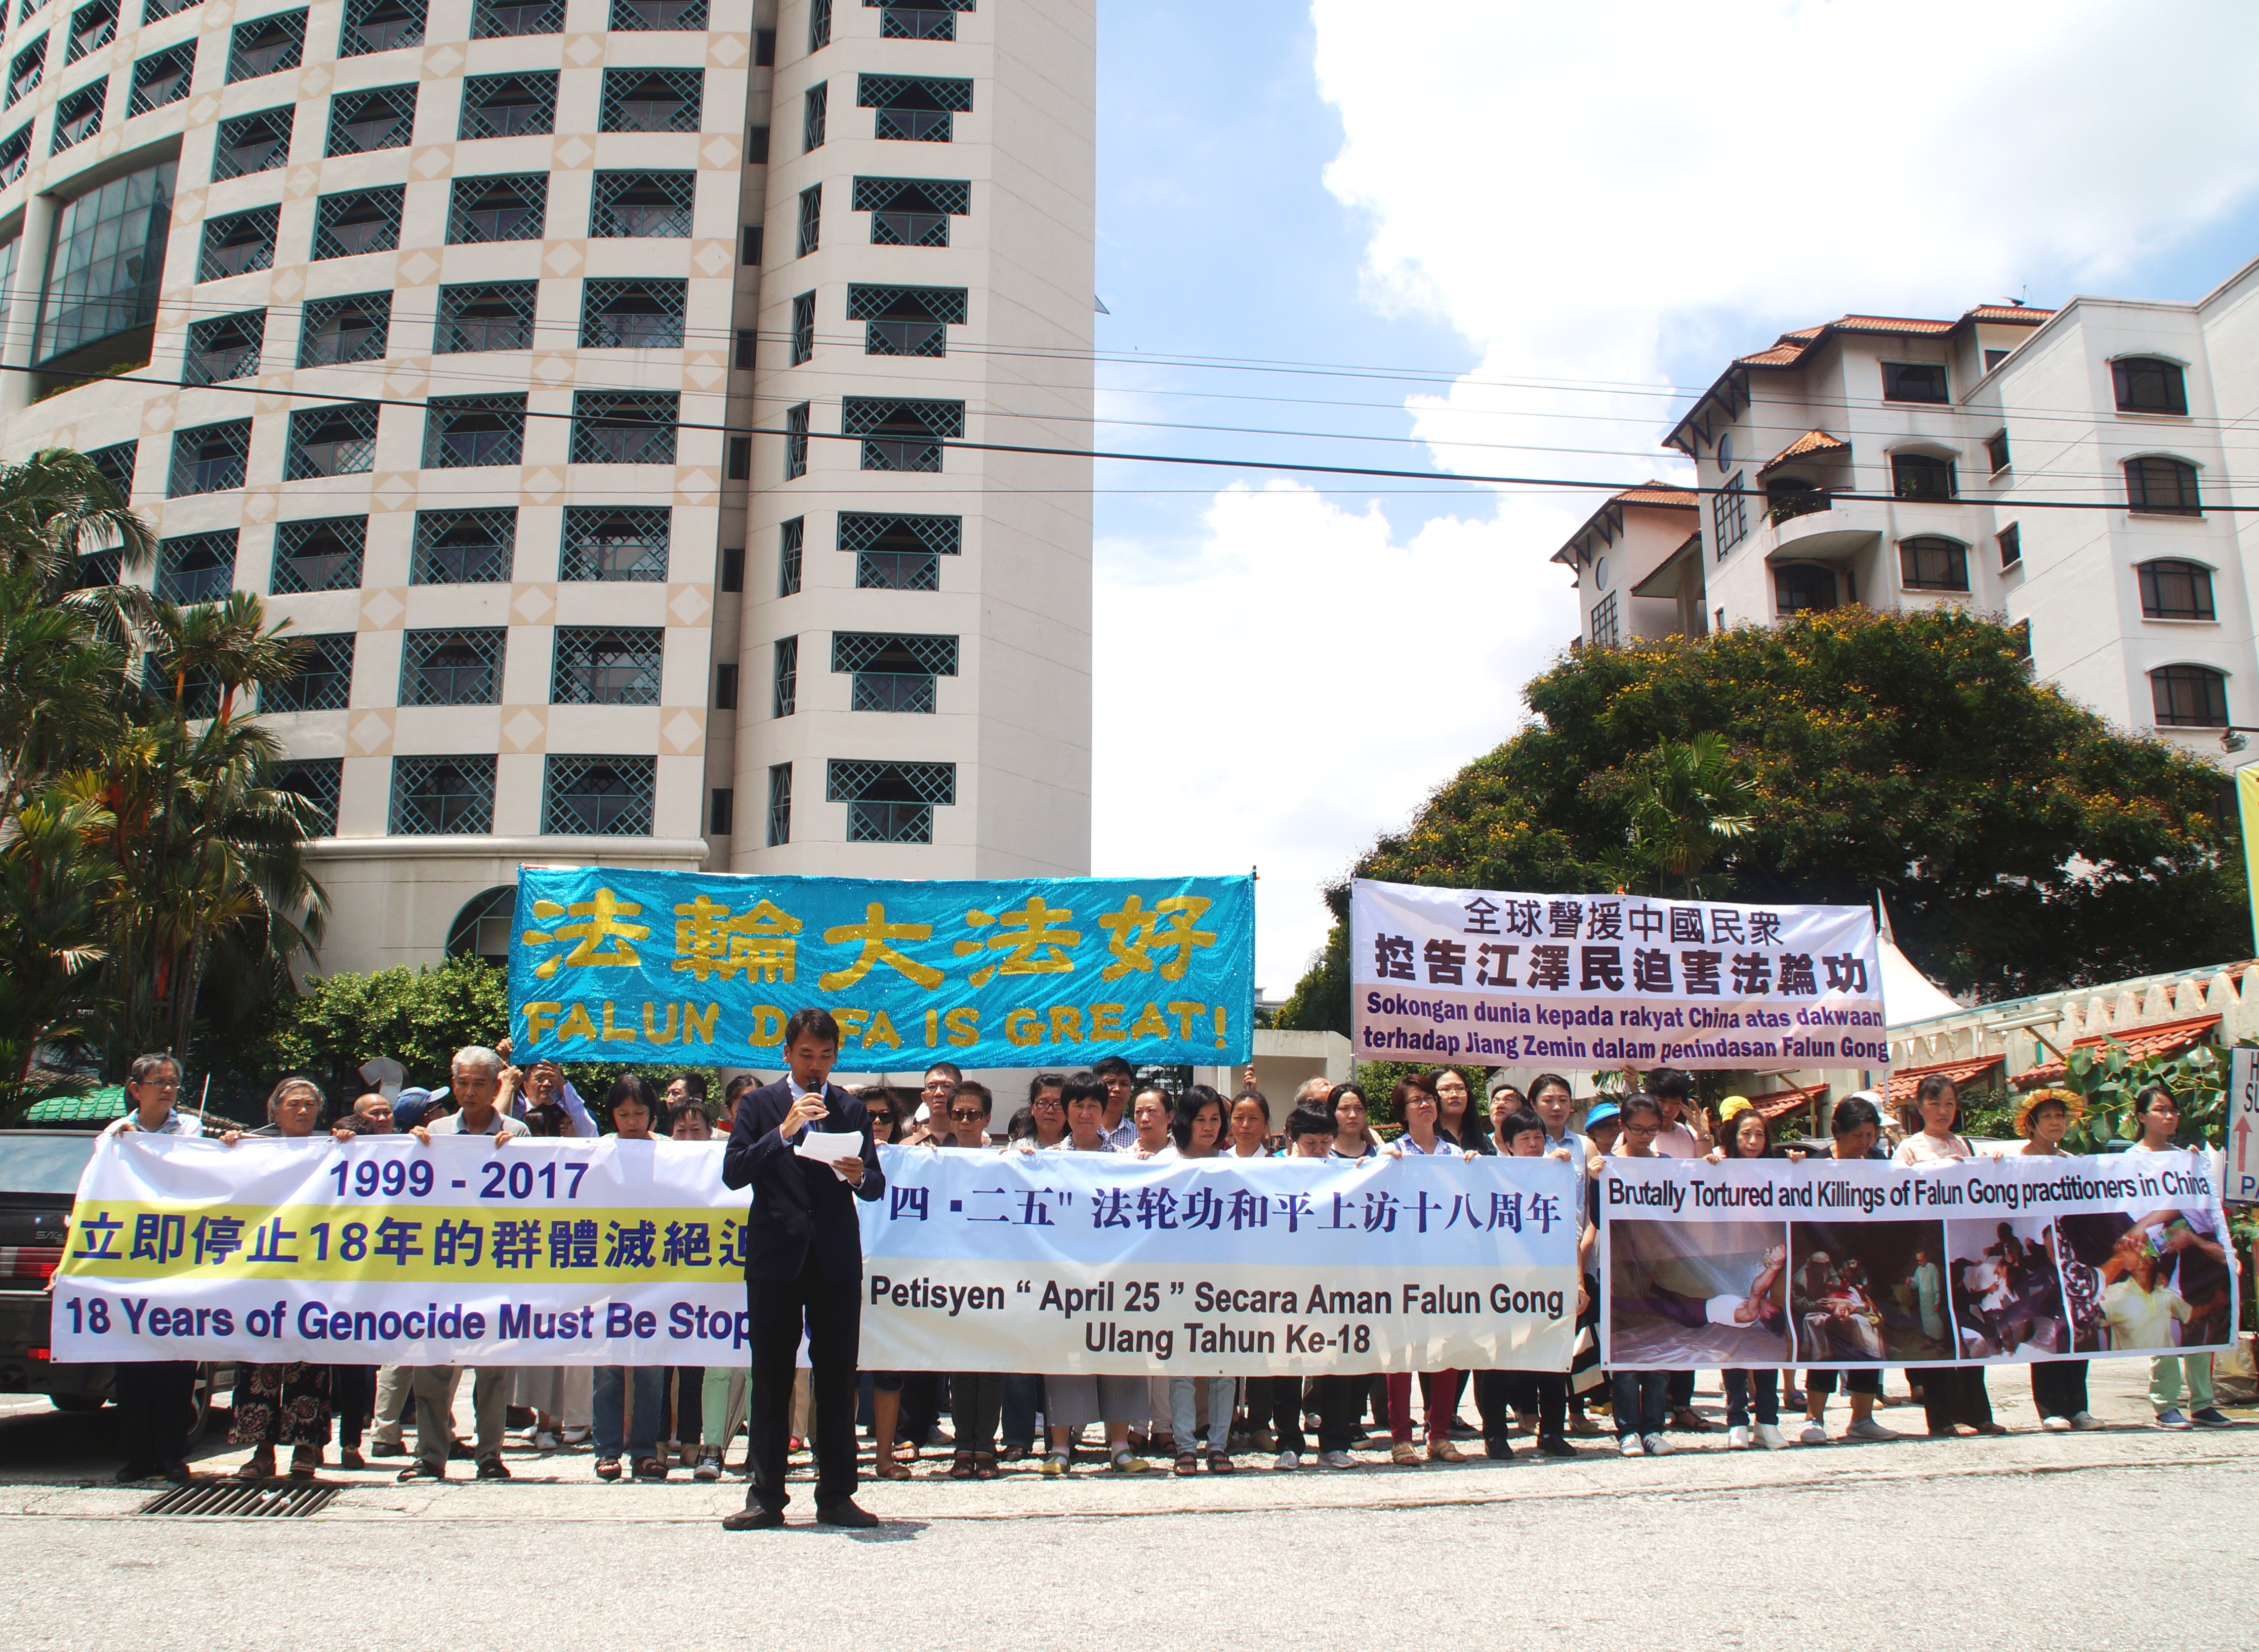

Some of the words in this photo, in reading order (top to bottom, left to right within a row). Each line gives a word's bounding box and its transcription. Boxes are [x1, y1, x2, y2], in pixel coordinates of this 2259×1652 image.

[523, 889, 1216, 990] 法輪大法好
[1375, 933, 1867, 996] 控告江澤民迫害法輪功
[523, 1002, 718, 1043] FALUN
[750, 1006, 900, 1049] DFA
[927, 1008, 978, 1047] IS
[1006, 1002, 1225, 1048] GREAT!
[1367, 992, 1467, 1022] Sokongan
[1474, 1001, 1531, 1023] dunia
[1537, 1004, 1613, 1029] kepada
[1620, 1007, 1683, 1031] rakyat
[1689, 1008, 1740, 1028] China
[1745, 1009, 1790, 1027] atas
[1796, 1007, 1883, 1026] dakwaan
[1364, 1026, 1459, 1056] terhadap
[1466, 1032, 1519, 1059] Jiang
[1523, 1035, 1586, 1057] Zemin
[1592, 1038, 1655, 1058] dalam
[1661, 1039, 1777, 1063] penindasan
[1782, 1037, 1834, 1057] Falun
[1841, 1037, 1889, 1063] Gong
[331, 1160, 434, 1196] 1999
[480, 1162, 588, 1199] 2017
[1609, 1178, 1686, 1213] Brutally
[1691, 1181, 1773, 1207] Tortured
[1779, 1181, 1812, 1207] and
[1818, 1181, 1885, 1213] Killings
[1891, 1180, 1910, 1206] of
[1915, 1179, 1963, 1205] Falun
[1967, 1178, 2018, 1209] Gong
[2023, 1175, 2137, 1209] practitioners
[2140, 1173, 2159, 1196] in
[2162, 1171, 2211, 1195] China
[1091, 1187, 1561, 1233] 法轮功和平上访十八周年
[35, 1231, 66, 1240] SAG
[67, 1297, 110, 1334] 18
[119, 1298, 234, 1337] Years
[246, 1301, 286, 1338] of
[298, 1301, 485, 1340] Genocide
[499, 1303, 593, 1340] Must
[606, 1303, 656, 1338] Be
[871, 1275, 1004, 1316] Petisyen
[1195, 1282, 1297, 1313] Secara
[1306, 1285, 1391, 1313] Aman
[1403, 1285, 1480, 1314] Falun
[1490, 1284, 1563, 1320] Gong
[1086, 1323, 1173, 1360] Ulang
[1184, 1323, 1274, 1353] Tahun
[1286, 1325, 1370, 1353] Ke-18
